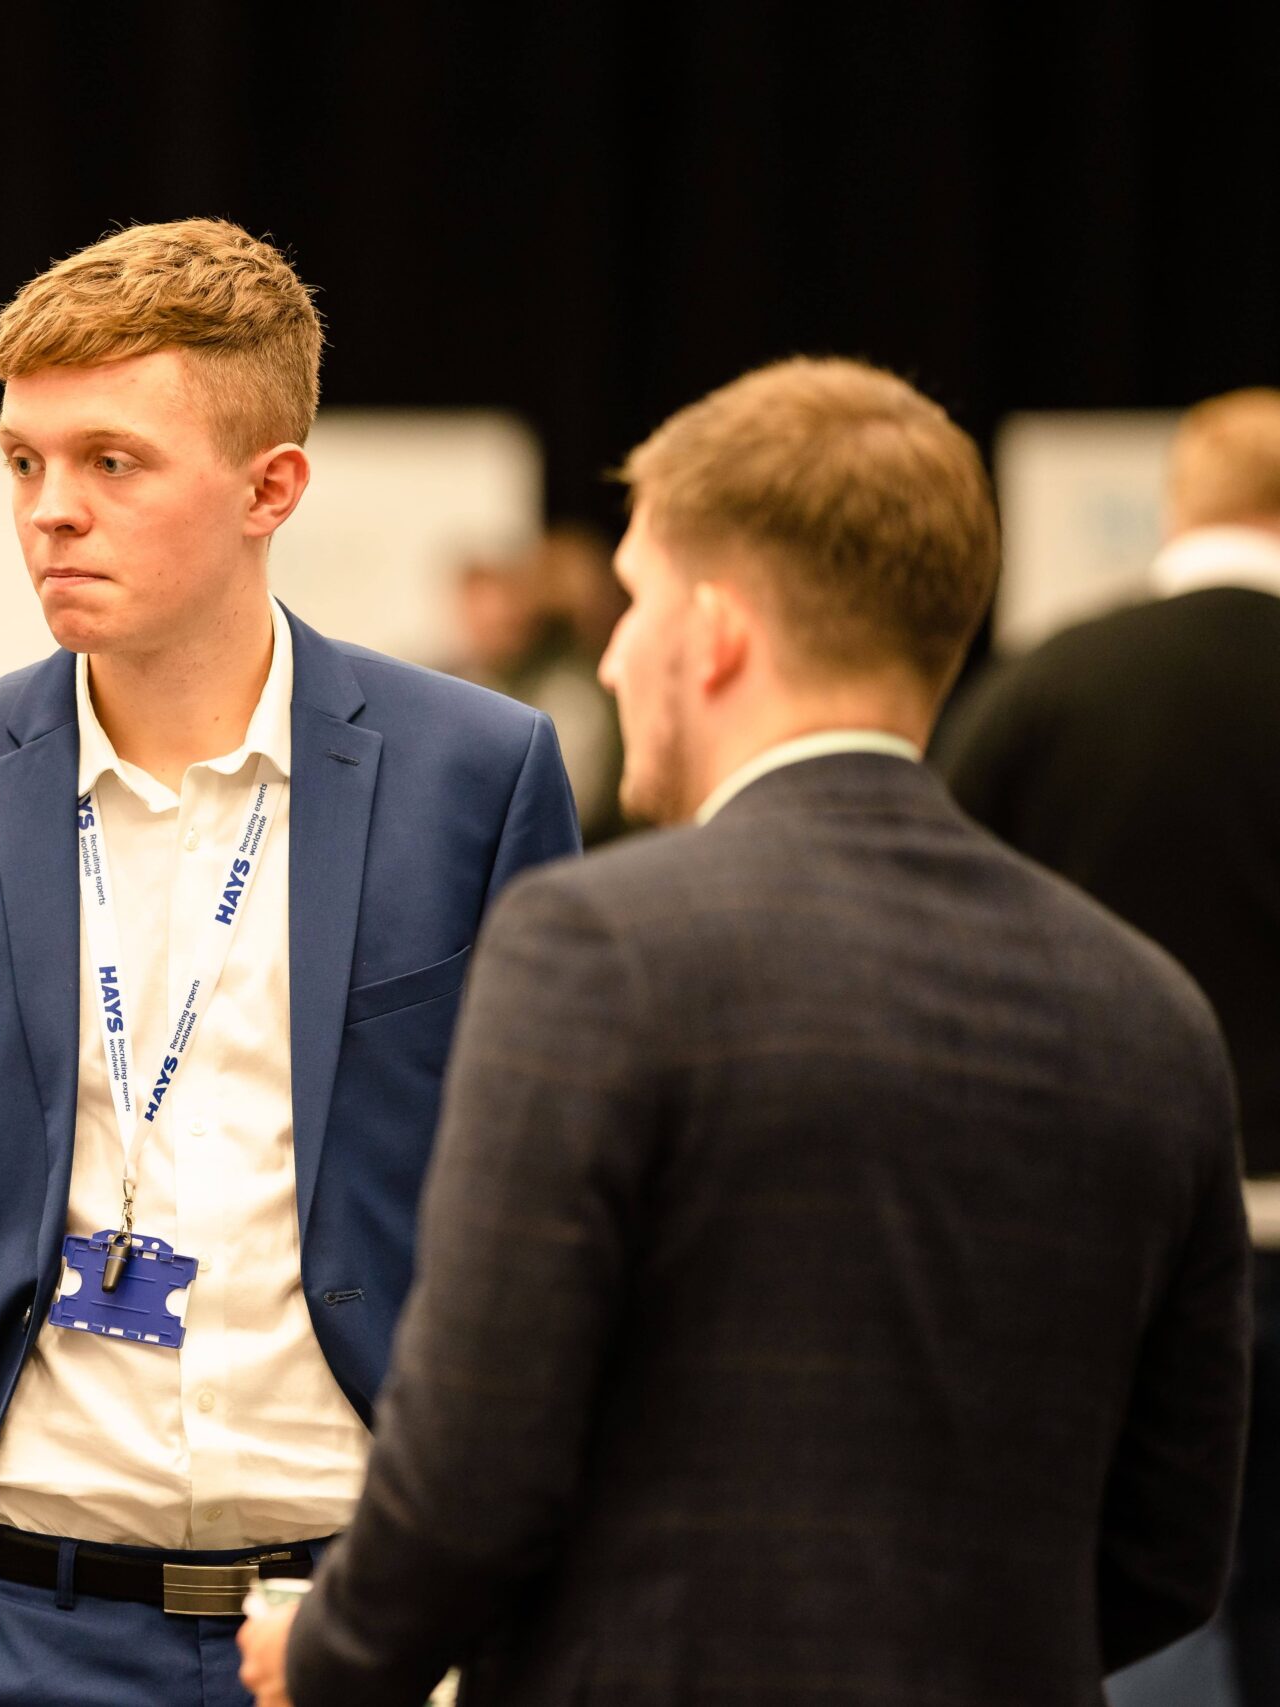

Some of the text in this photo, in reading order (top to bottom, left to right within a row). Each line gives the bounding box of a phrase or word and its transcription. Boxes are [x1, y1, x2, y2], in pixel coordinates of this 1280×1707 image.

[239, 783, 268, 853] Recruiting experts
[249, 815, 268, 856] worldwide
[81, 836, 91, 877] worldwide
[90, 833, 106, 906] Recruiting experts
[215, 858, 251, 926] HAYS
[99, 966, 124, 1033] HAYS
[170, 979, 201, 1050] Recruiting experts
[178, 1012, 197, 1053] worldwide
[109, 1038, 119, 1081] worldwide
[118, 1038, 131, 1112] Recruiting experts
[144, 1055, 178, 1122] HAYS
